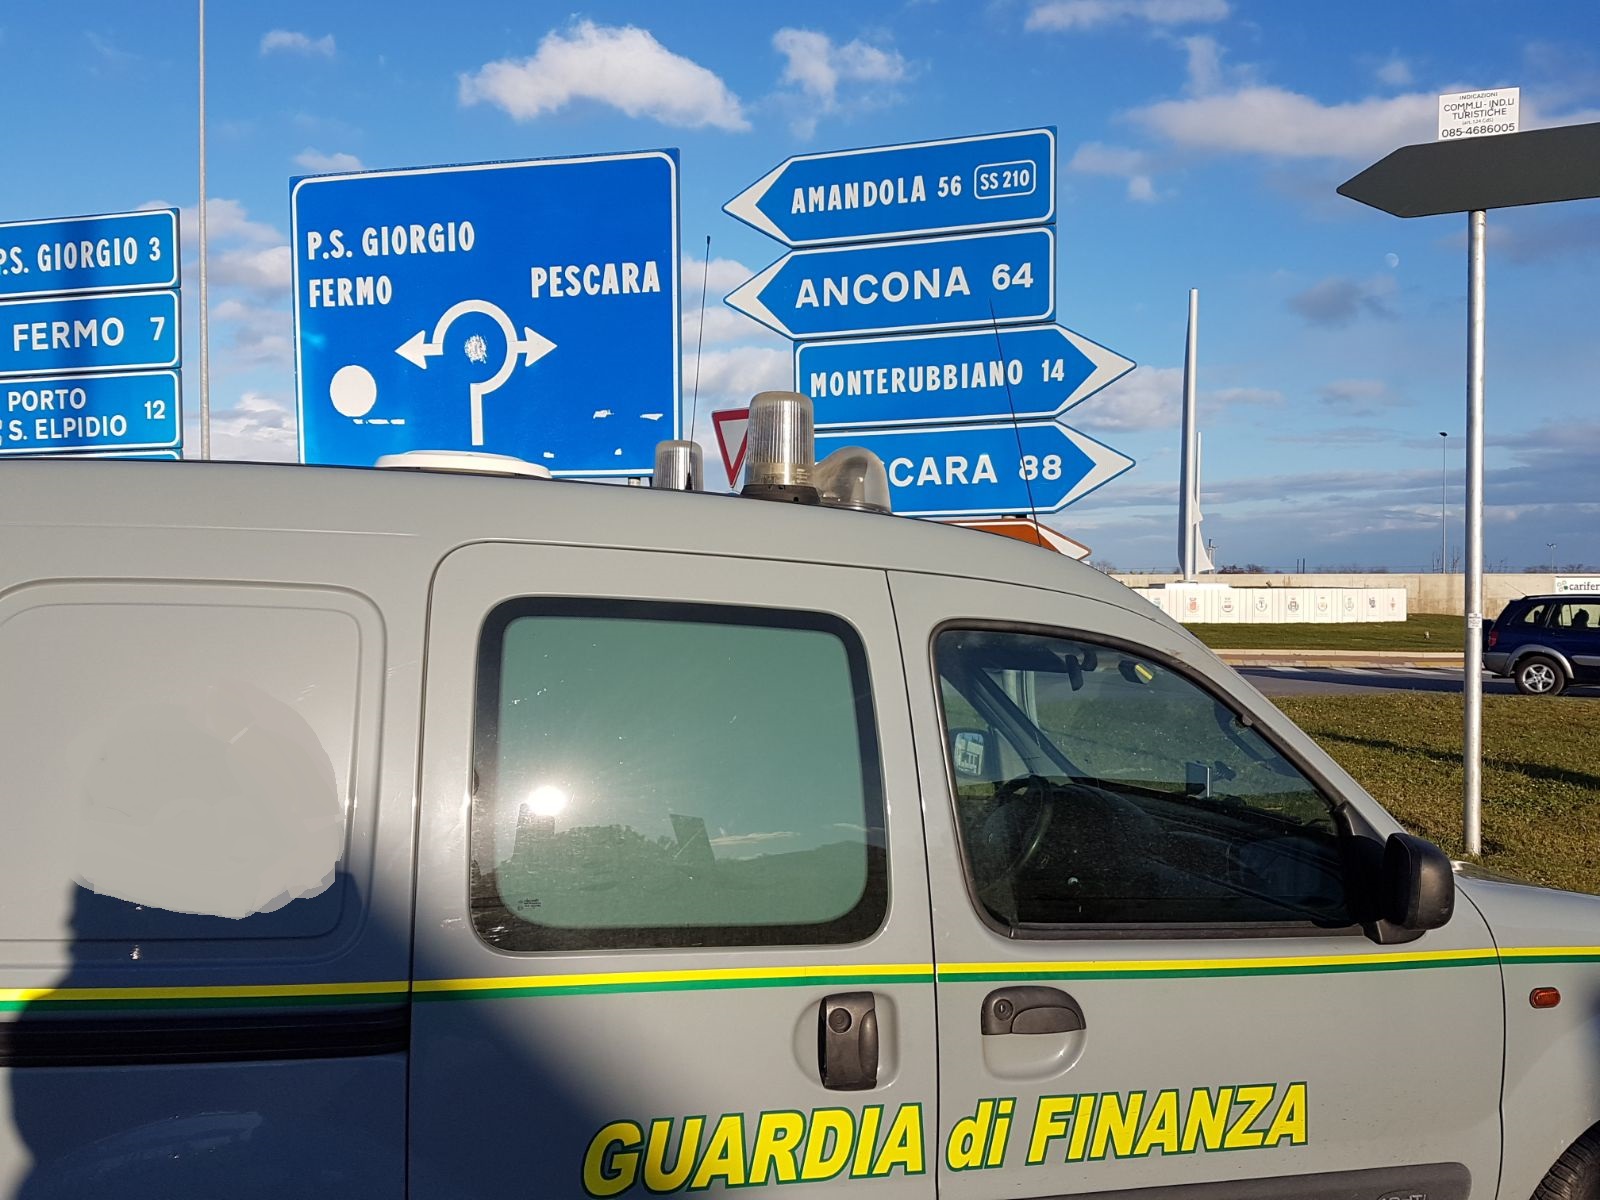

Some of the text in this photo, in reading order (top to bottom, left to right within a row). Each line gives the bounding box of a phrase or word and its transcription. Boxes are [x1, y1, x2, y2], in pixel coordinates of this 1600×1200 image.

[1452, 107, 1507, 120] TURISTICHE
[1459, 92, 1498, 101] INDICAZIONI
[1441, 122, 1515, 138] 085-4686005
[791, 175, 962, 214] AMANDOLA 56
[980, 169, 1030, 191] SS 210
[37, 236, 138, 272] GIORGIO
[148, 236, 161, 261] 3
[307, 221, 475, 260] P.S. GIORGIO
[309, 275, 393, 308] FERMO
[531, 260, 661, 298] PESCARA
[795, 262, 1034, 309] ANCONA 64
[13, 316, 165, 352] FERMO 7
[810, 358, 1065, 398] MONTERUBBIANO 14
[8, 387, 86, 412] PORTO
[8, 399, 166, 441] S. ELPIDIO 12
[882, 453, 1062, 488] CARA 88
[581, 1081, 1308, 1199] GUARDIA di FINANZA
